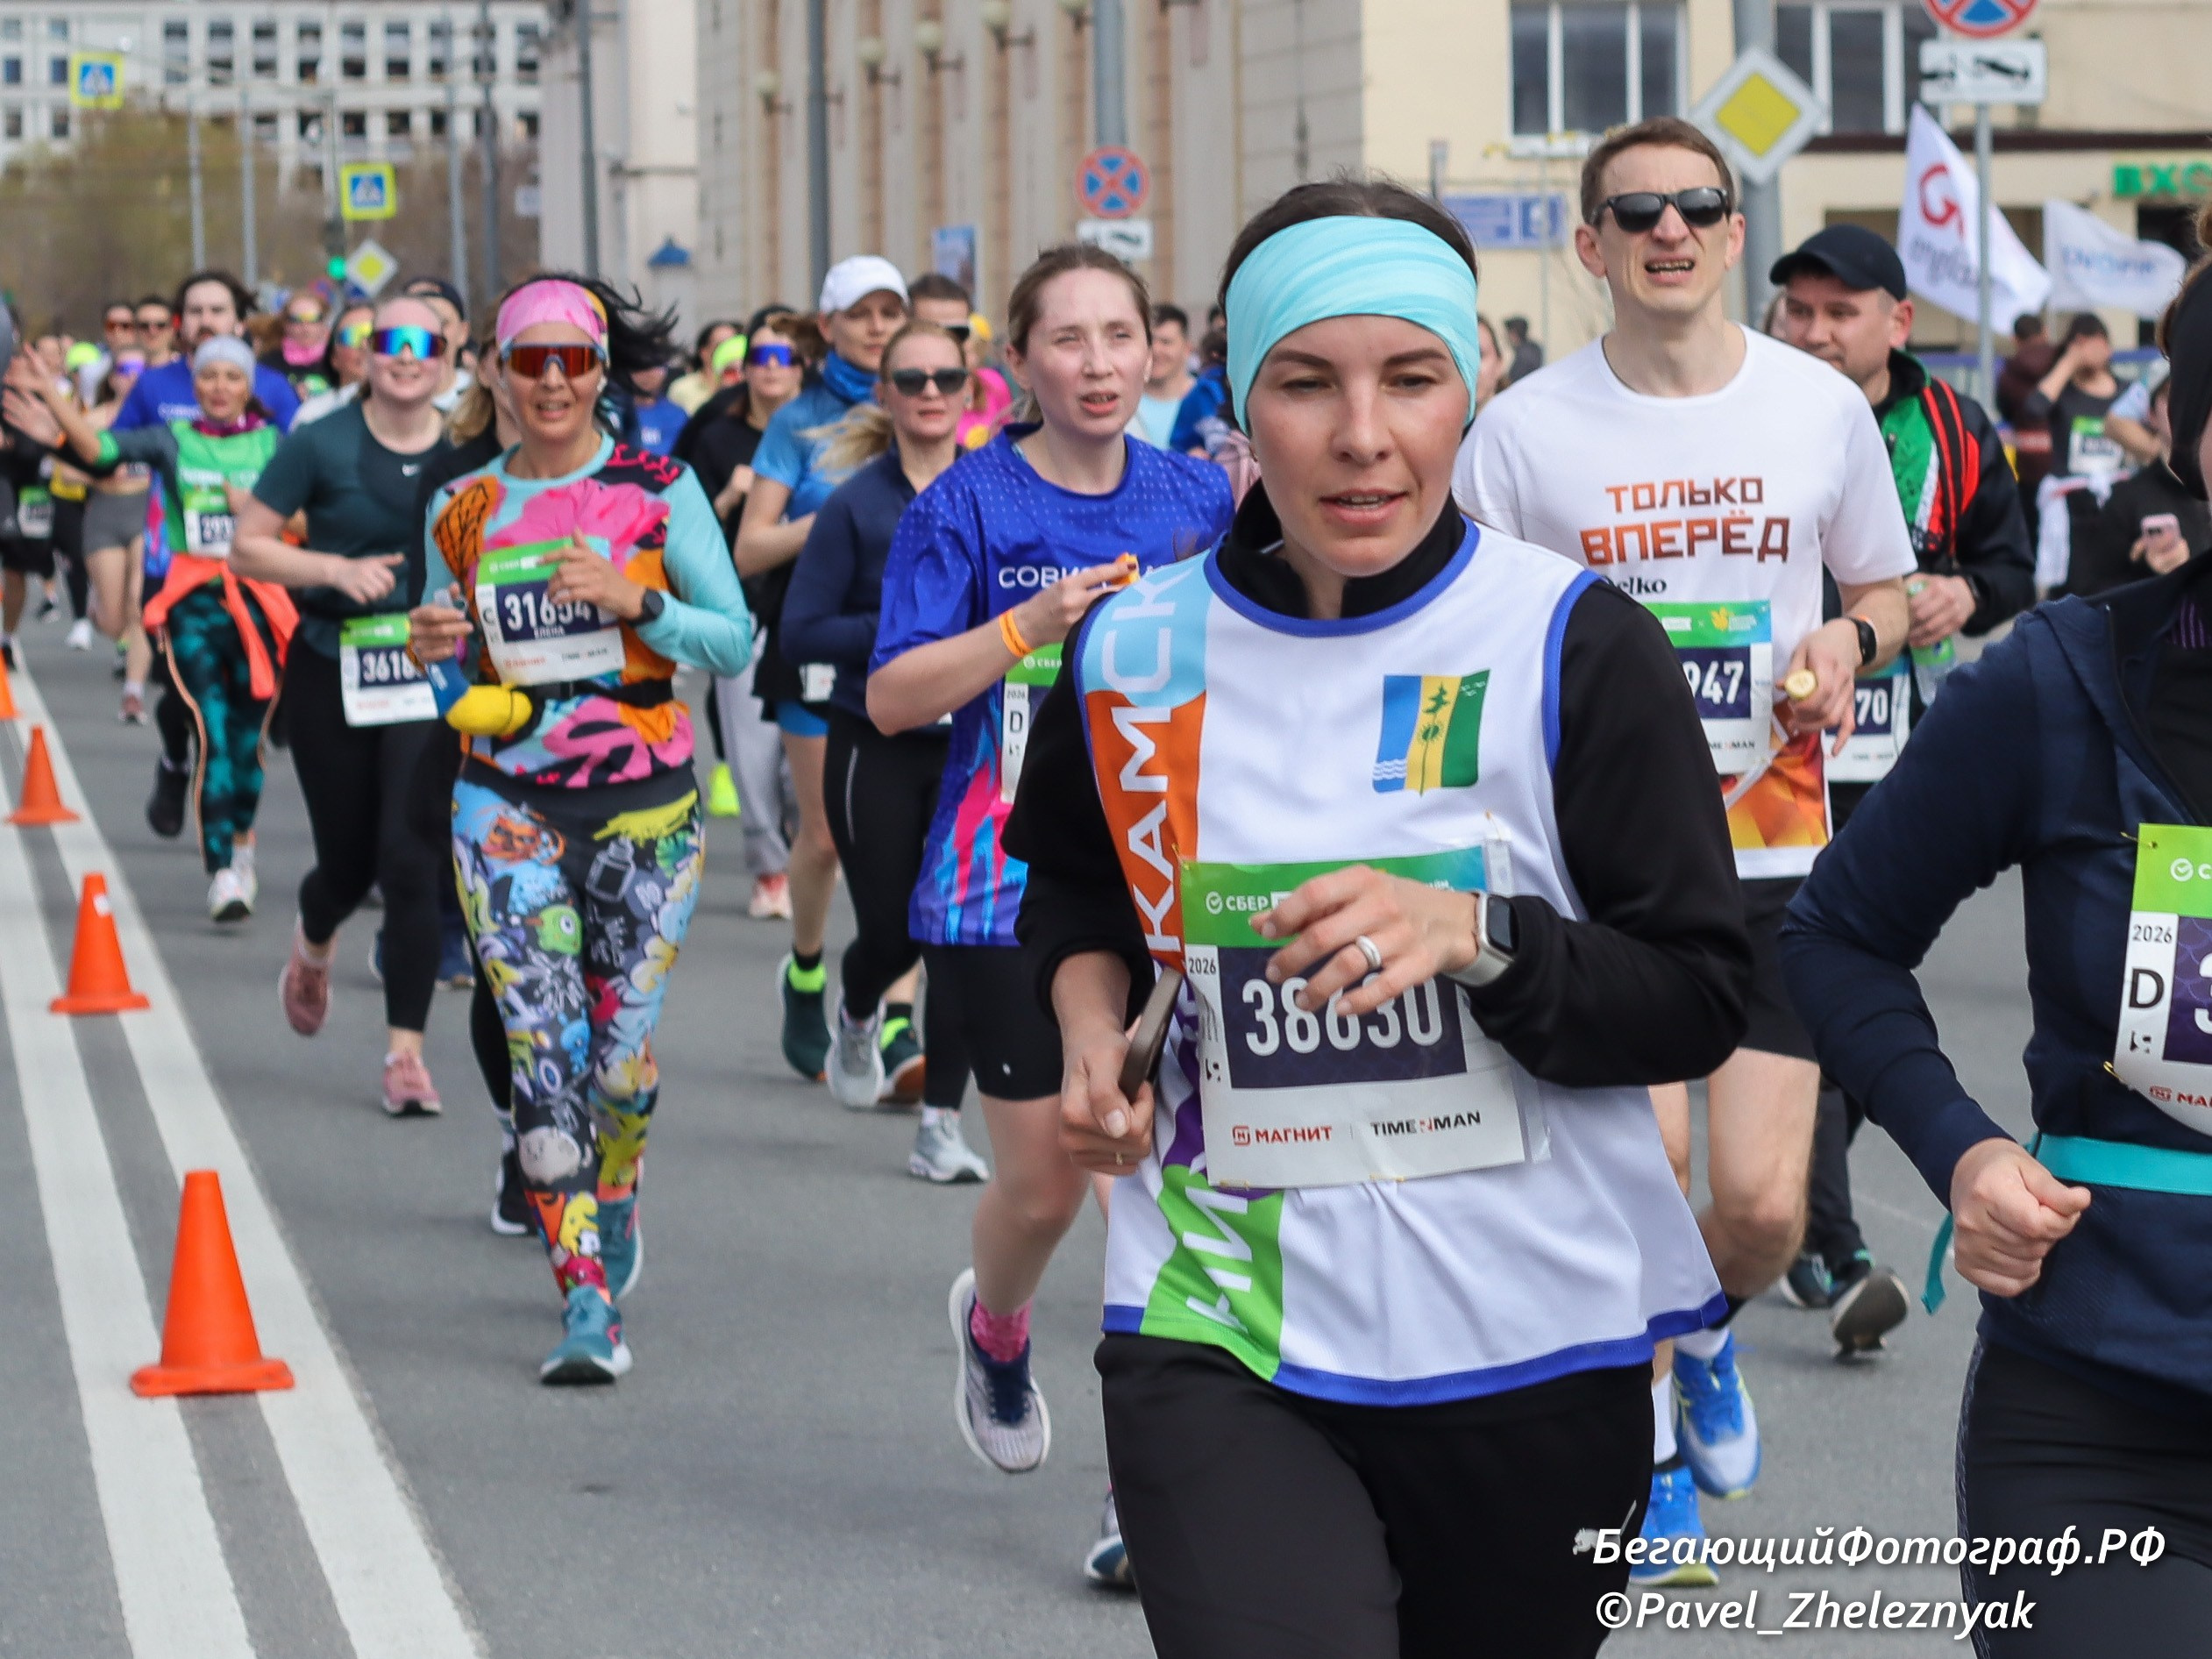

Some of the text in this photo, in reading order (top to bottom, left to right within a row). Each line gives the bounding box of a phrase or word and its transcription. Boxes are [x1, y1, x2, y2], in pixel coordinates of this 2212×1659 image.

[1605, 476, 1764, 514] ТОЛЬКО
[1580, 509, 1790, 567] ВПЕРЁД
[1010, 710, 1023, 733] D
[1226, 894, 1269, 911] СБЕР
[2132, 924, 2173, 944] 2026
[1189, 957, 1217, 975] 2026
[2129, 967, 2165, 1010] D
[1255, 1125, 1333, 1144] МАГНИТ
